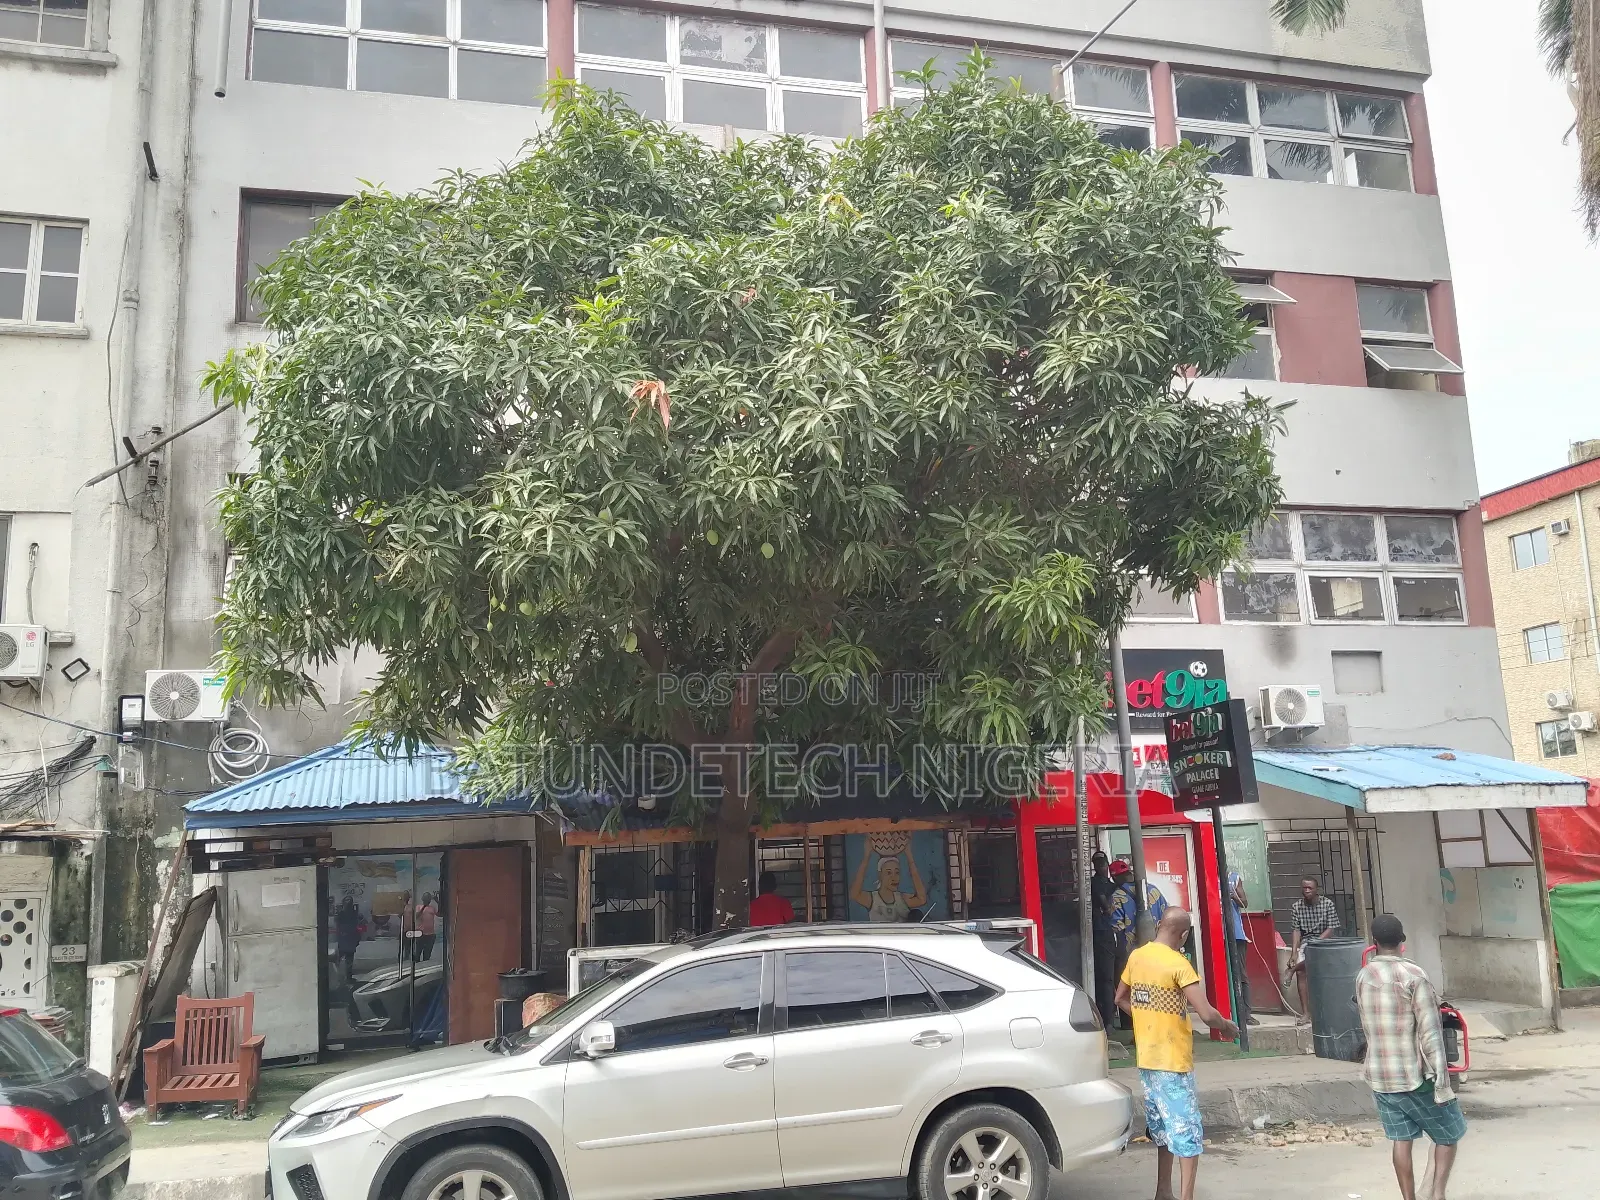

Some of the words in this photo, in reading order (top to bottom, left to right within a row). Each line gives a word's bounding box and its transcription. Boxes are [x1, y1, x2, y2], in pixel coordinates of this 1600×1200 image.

[1104, 662, 1227, 709] et9ja
[1170, 707, 1223, 742] bet9ja
[1186, 769, 1217, 783] PALACE
[61, 946, 76, 956] 23
